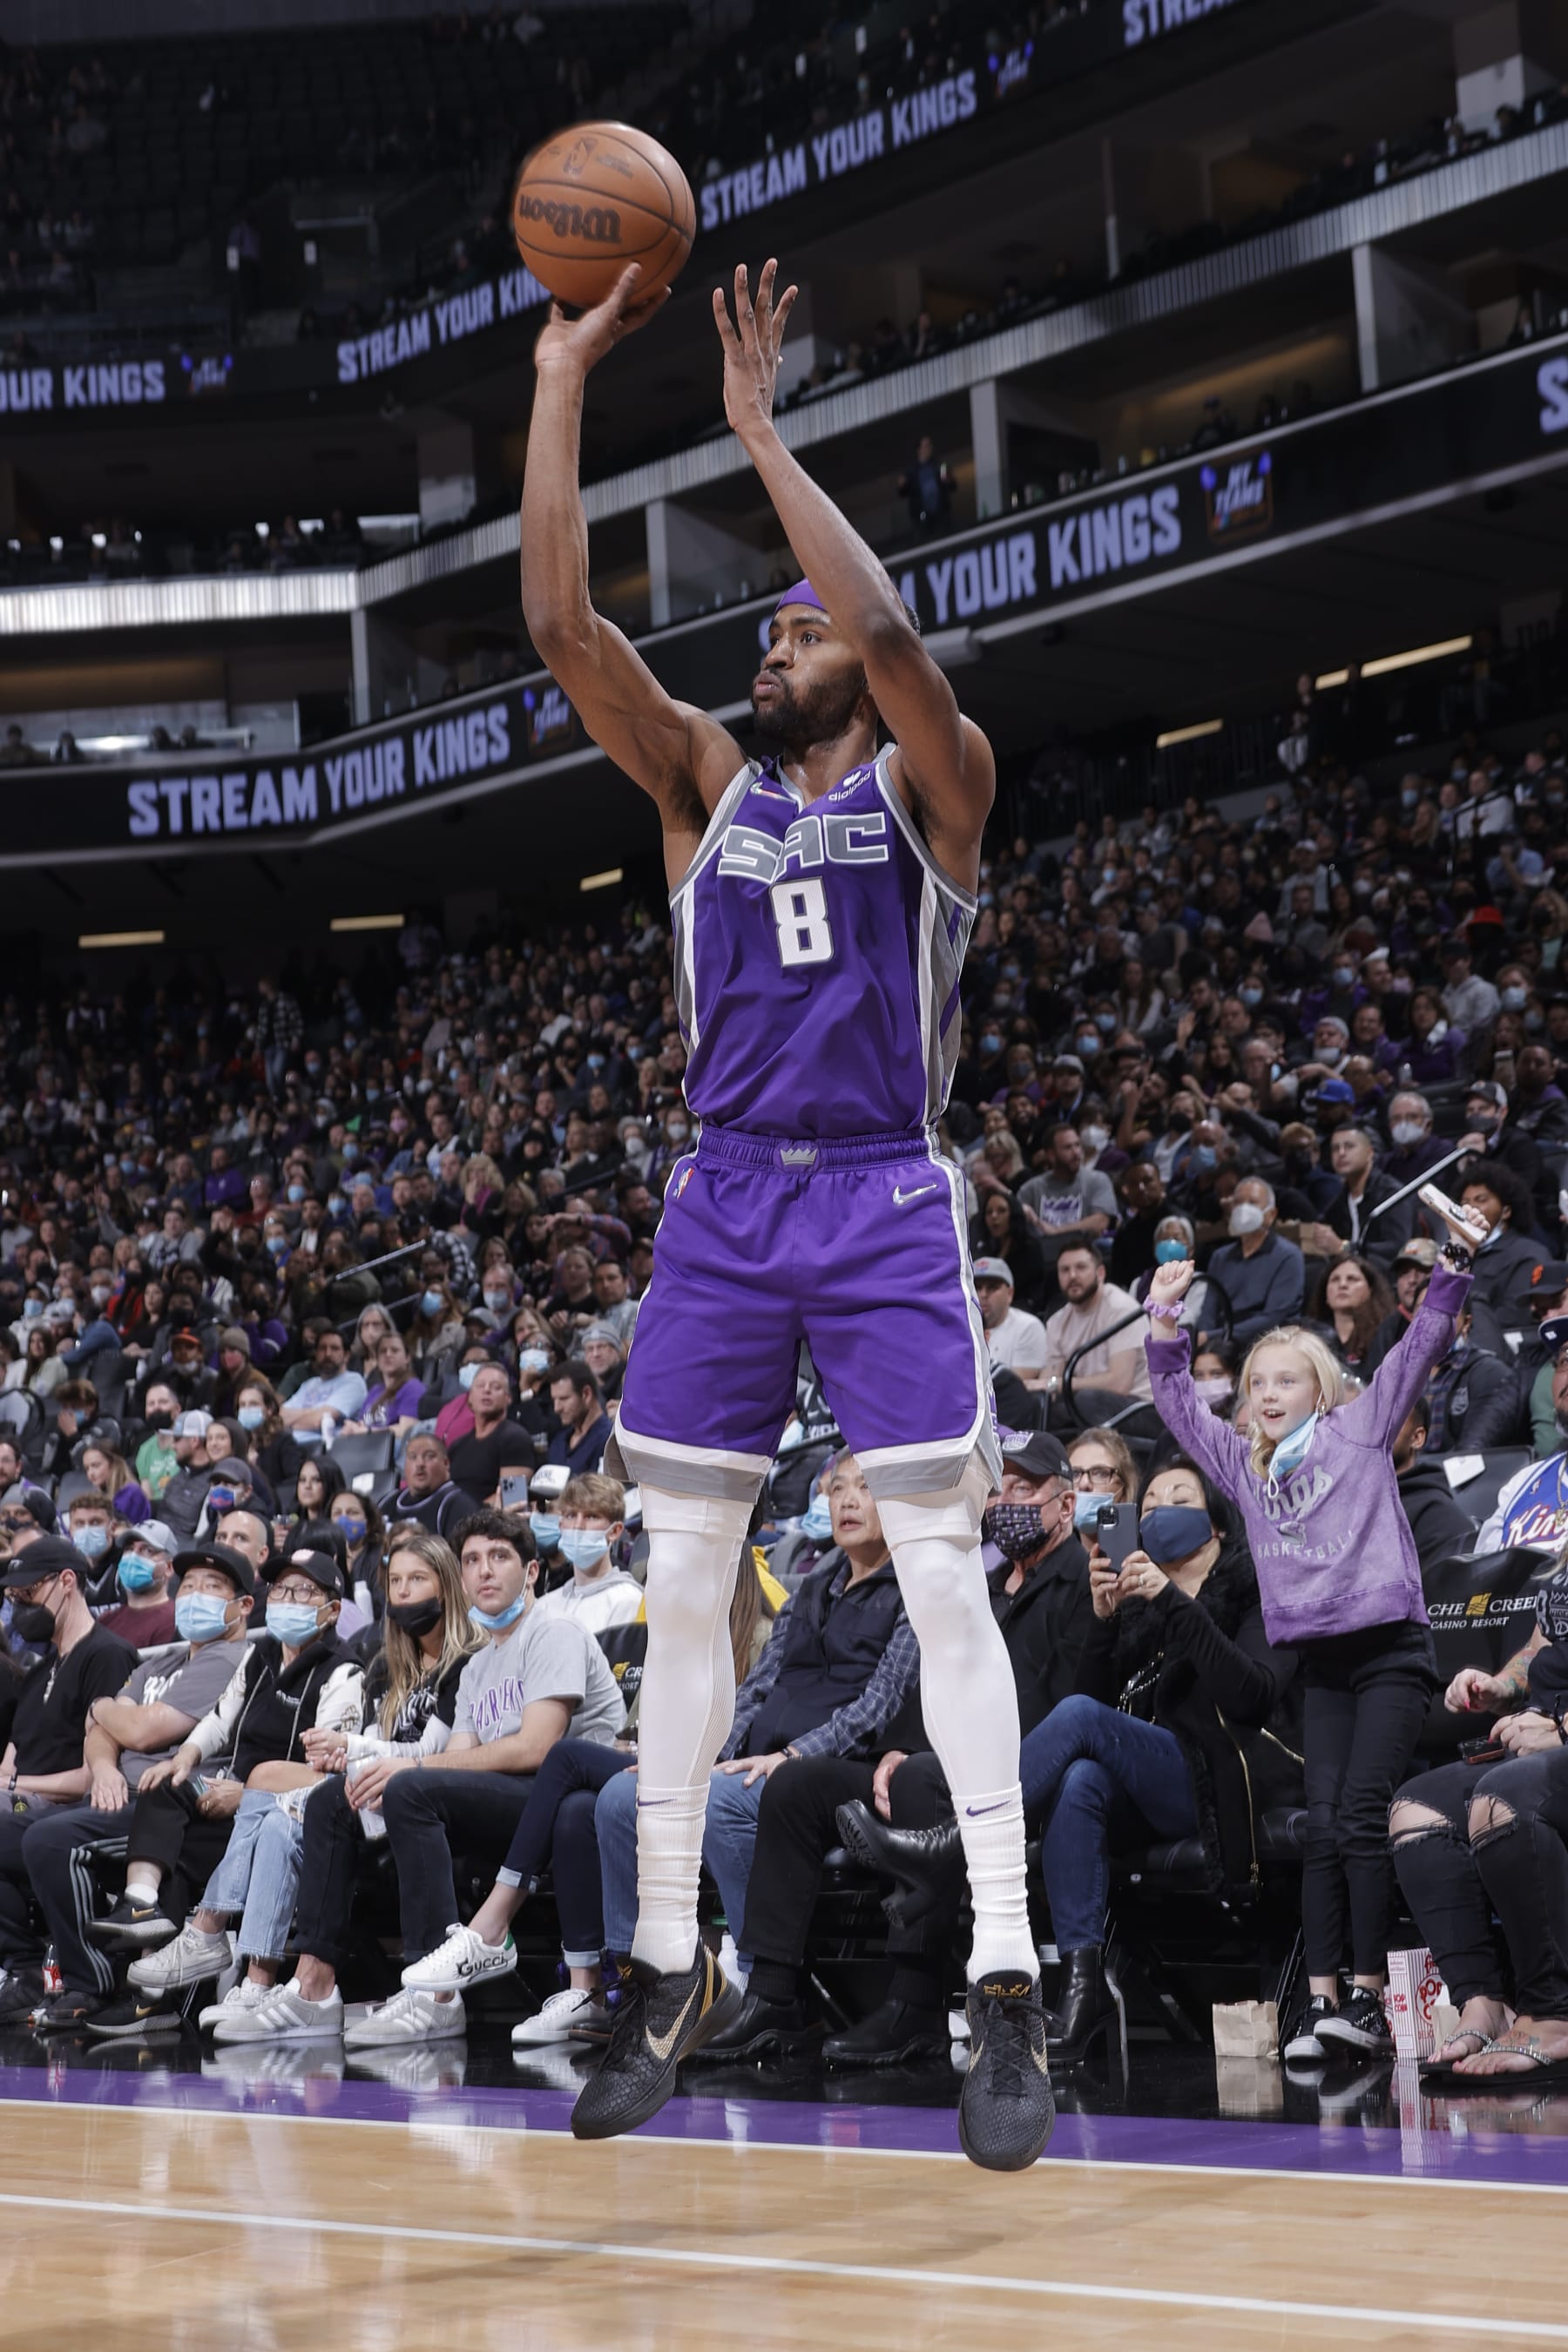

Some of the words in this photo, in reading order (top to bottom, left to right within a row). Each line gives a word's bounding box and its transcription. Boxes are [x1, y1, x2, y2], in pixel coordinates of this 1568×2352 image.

[700, 143, 807, 232] STREAM
[812, 109, 884, 181] YOUR
[890, 68, 977, 149] KINGS
[337, 309, 430, 384] STREAM
[436, 281, 494, 344] YOUR
[63, 361, 166, 409] KINGS
[926, 531, 1037, 625] YOUR
[1047, 483, 1182, 589] KINGS
[127, 764, 319, 837] STREAM
[324, 735, 405, 814] YOUR
[413, 702, 510, 787] KINGS
[828, 770, 871, 802] dialpad
[717, 811, 889, 885] SAC
[768, 875, 835, 969] 8
[1430, 1619, 1467, 1629] CASINO
[1472, 1617, 1510, 1627] RESORT
